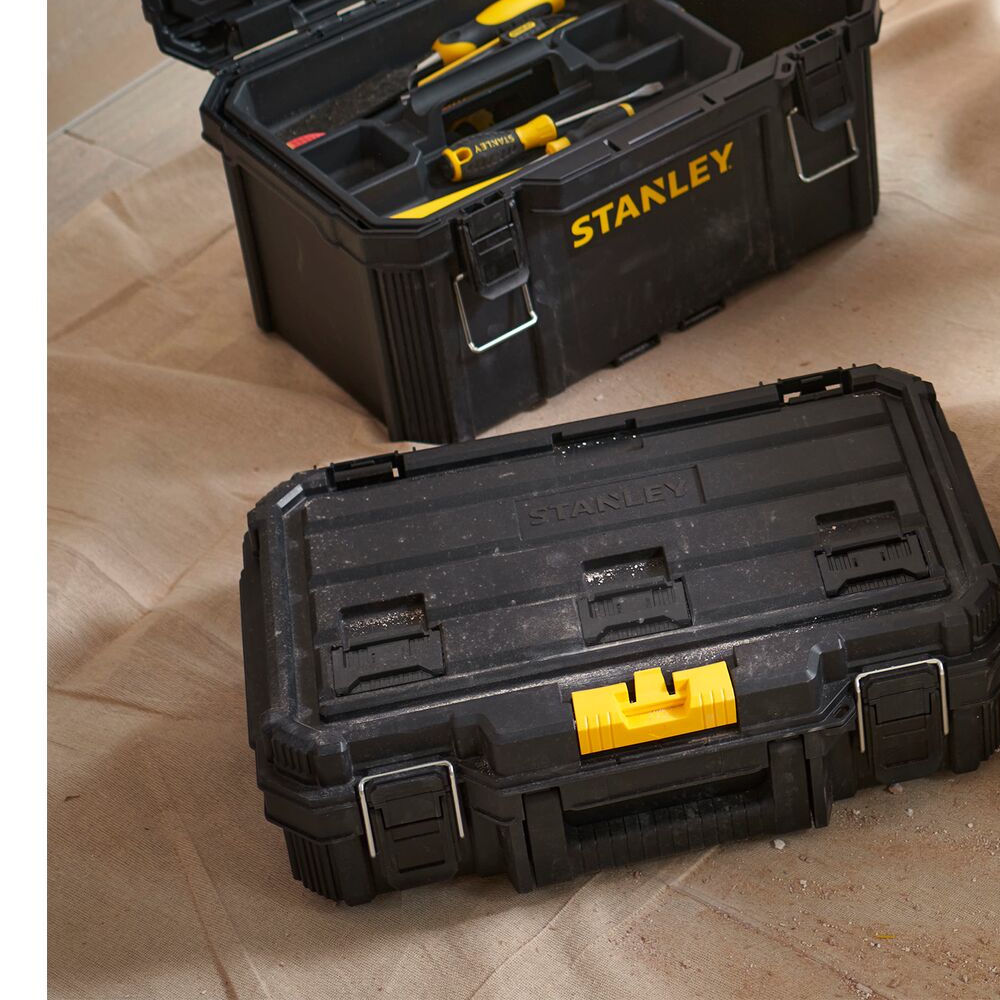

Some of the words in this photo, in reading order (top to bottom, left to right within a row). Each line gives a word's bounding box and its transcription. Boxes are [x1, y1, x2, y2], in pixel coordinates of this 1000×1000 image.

[474, 134, 515, 154] STANLEY
[571, 141, 733, 248] STANLEY
[527, 479, 688, 527] STANLEY
